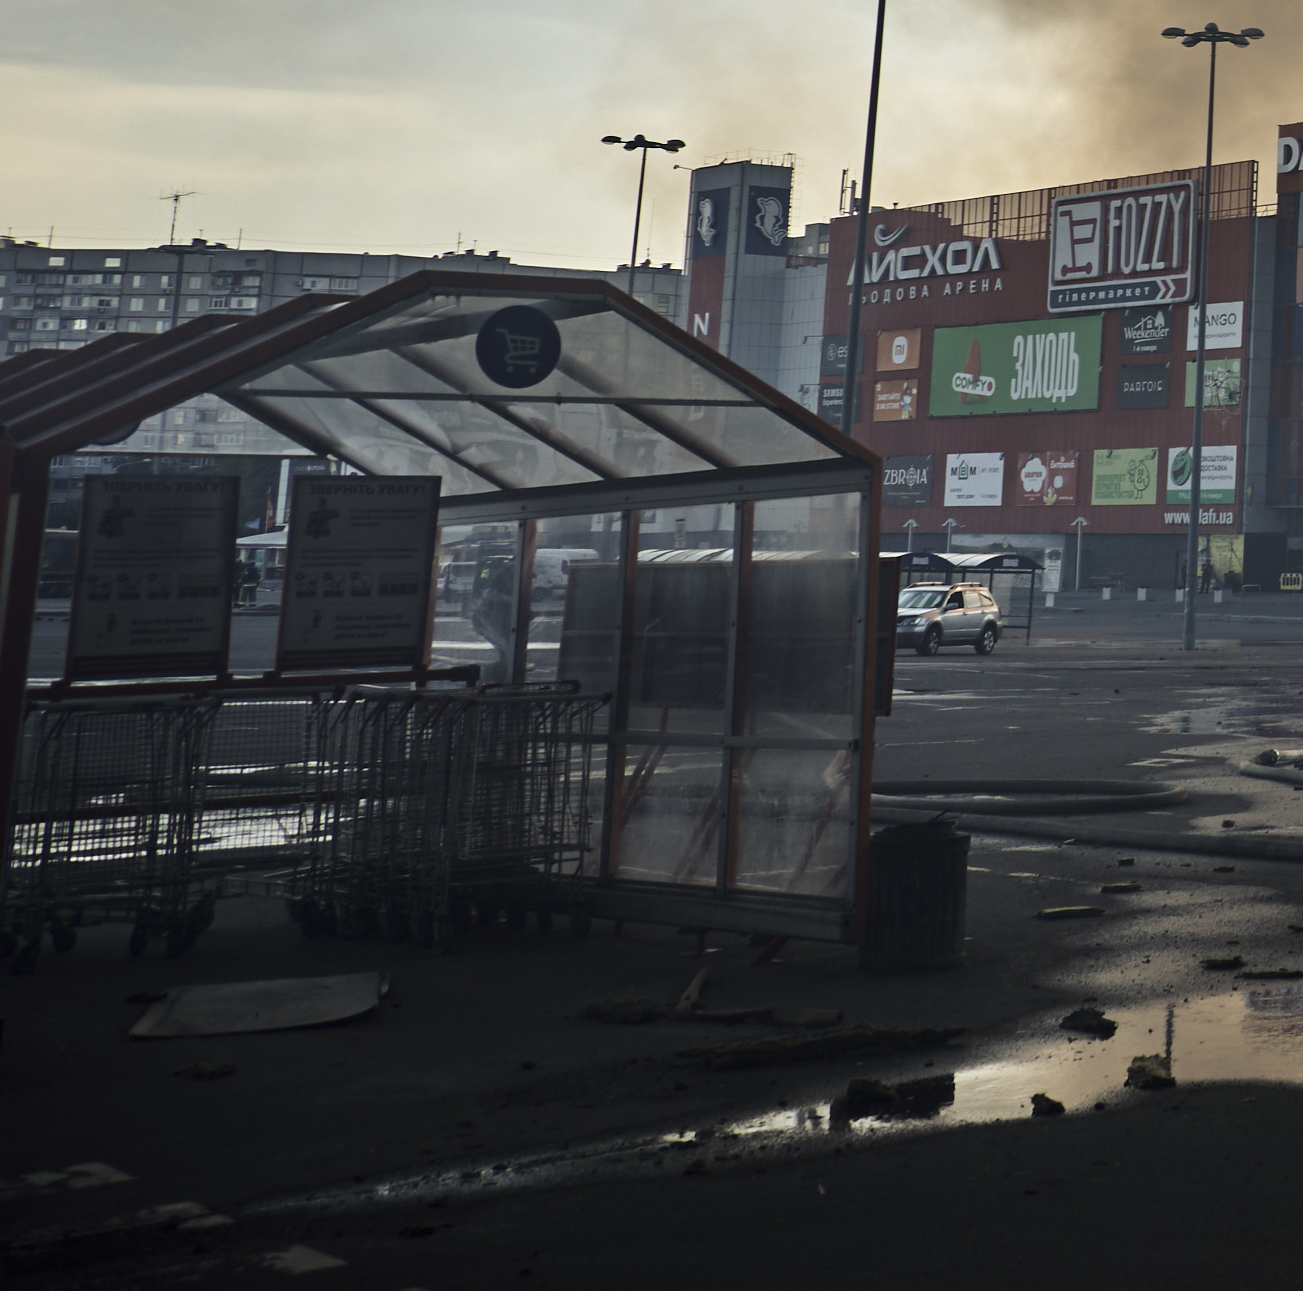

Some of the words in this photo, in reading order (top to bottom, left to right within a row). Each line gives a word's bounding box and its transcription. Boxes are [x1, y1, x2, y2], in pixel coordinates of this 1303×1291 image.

[1108, 191, 1186, 275] FOZZY
[943, 277, 1003, 296] АРЕНА
[1123, 326, 1170, 340] Weekender
[1010, 331, 1080, 403] ЗАХОДЬ
[954, 376, 987, 392] COMFY
[101, 481, 170, 492] ЗВЕРНІТЬ
[308, 484, 374, 495] ЗВЕРНІТЬ
